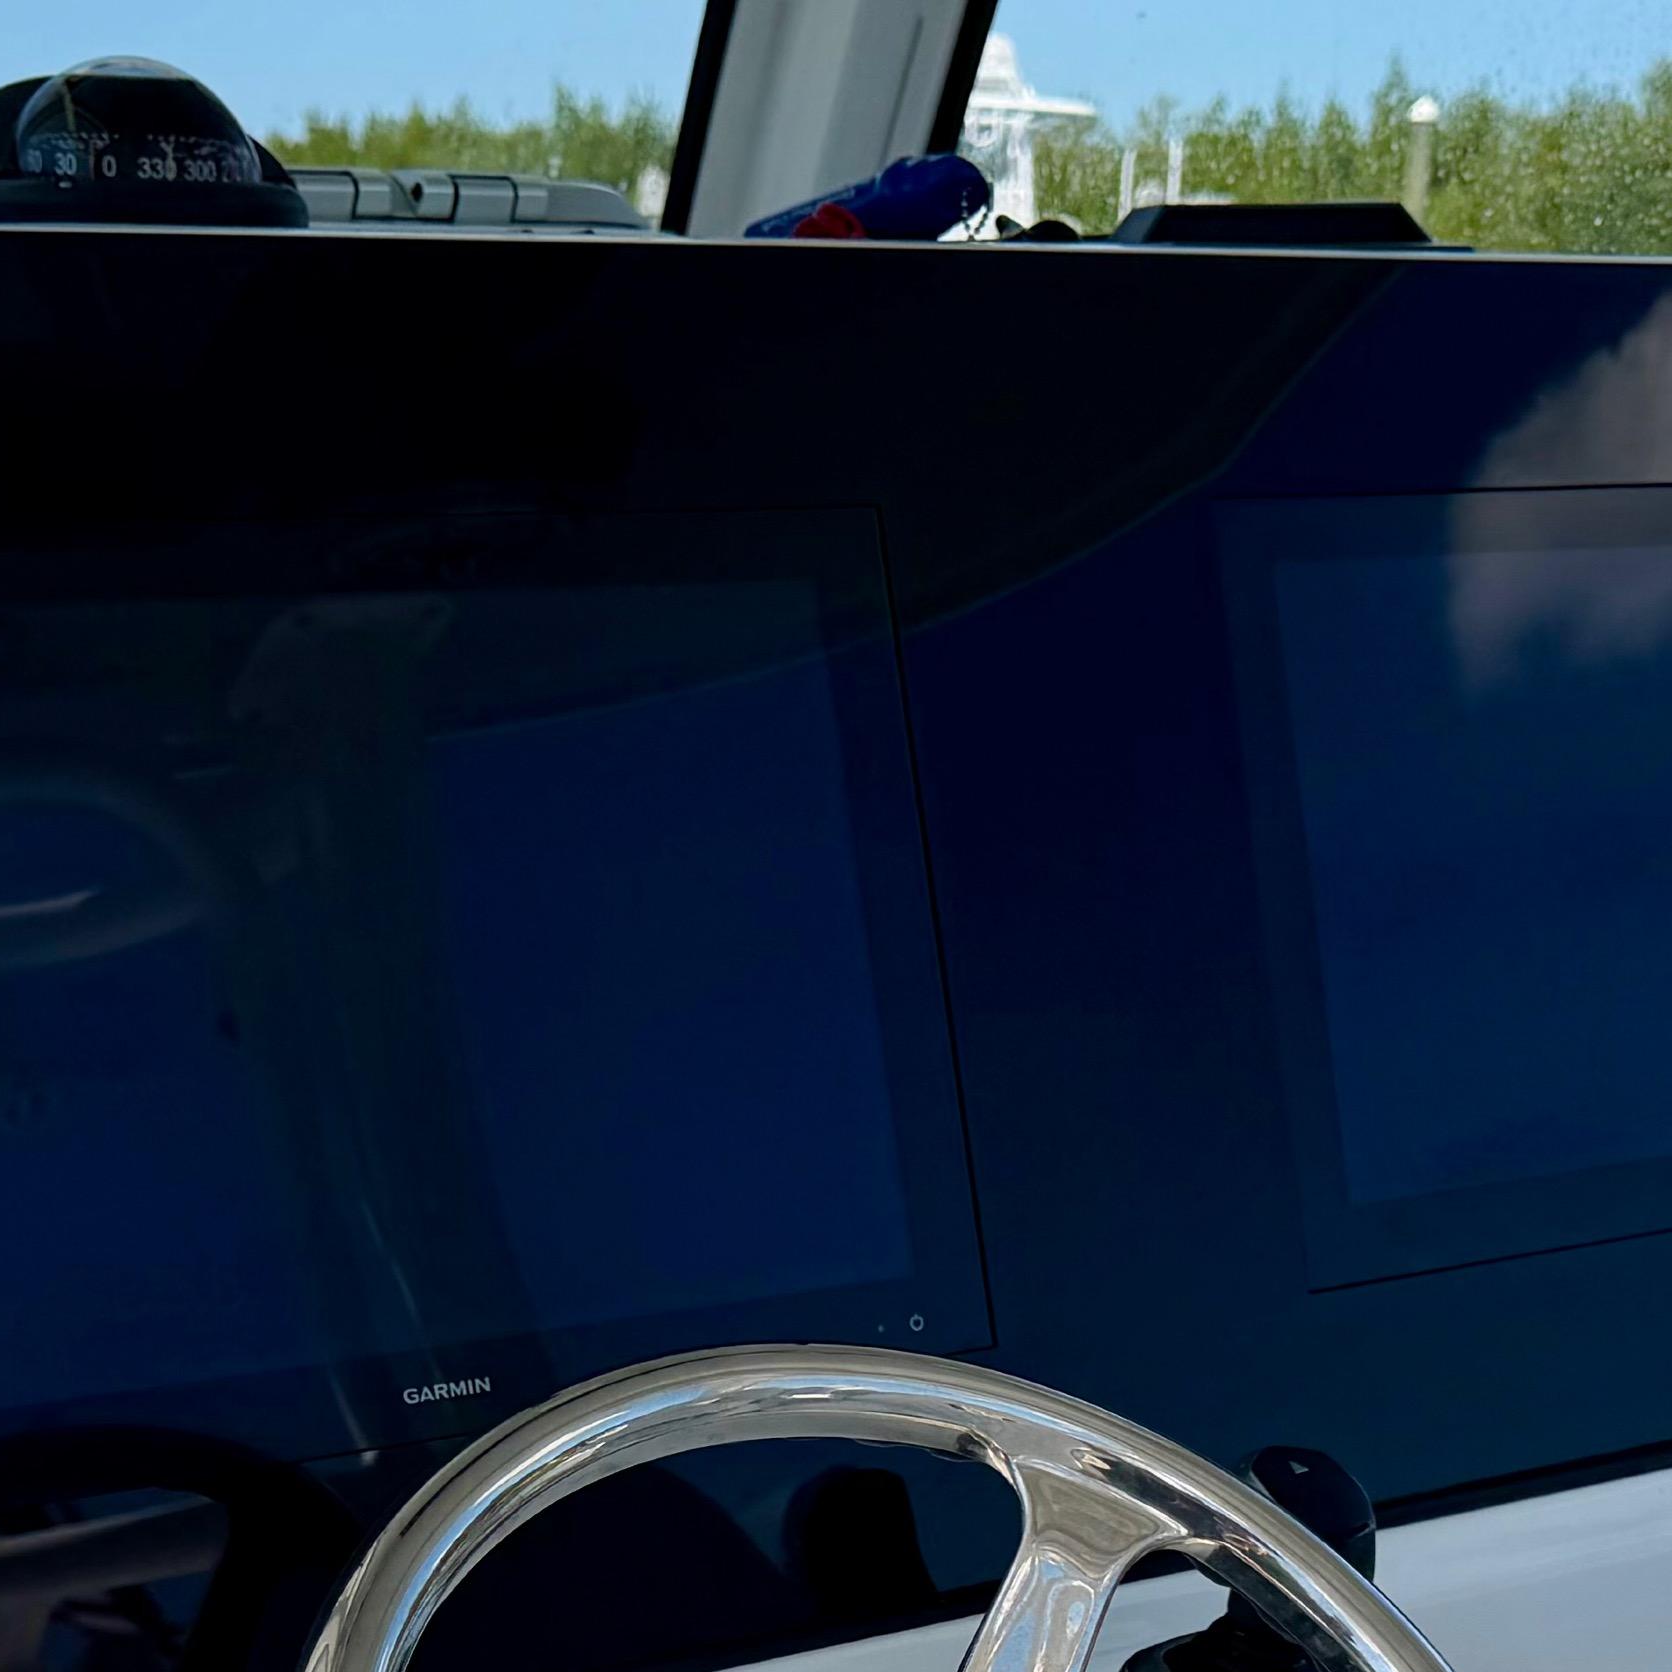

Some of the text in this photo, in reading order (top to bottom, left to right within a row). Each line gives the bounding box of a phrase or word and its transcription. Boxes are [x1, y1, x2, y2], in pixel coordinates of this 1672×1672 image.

[54, 151, 78, 177] 30
[101, 154, 117, 178] 0
[183, 158, 217, 182] 300
[403, 1376, 491, 1405] GARMIN
